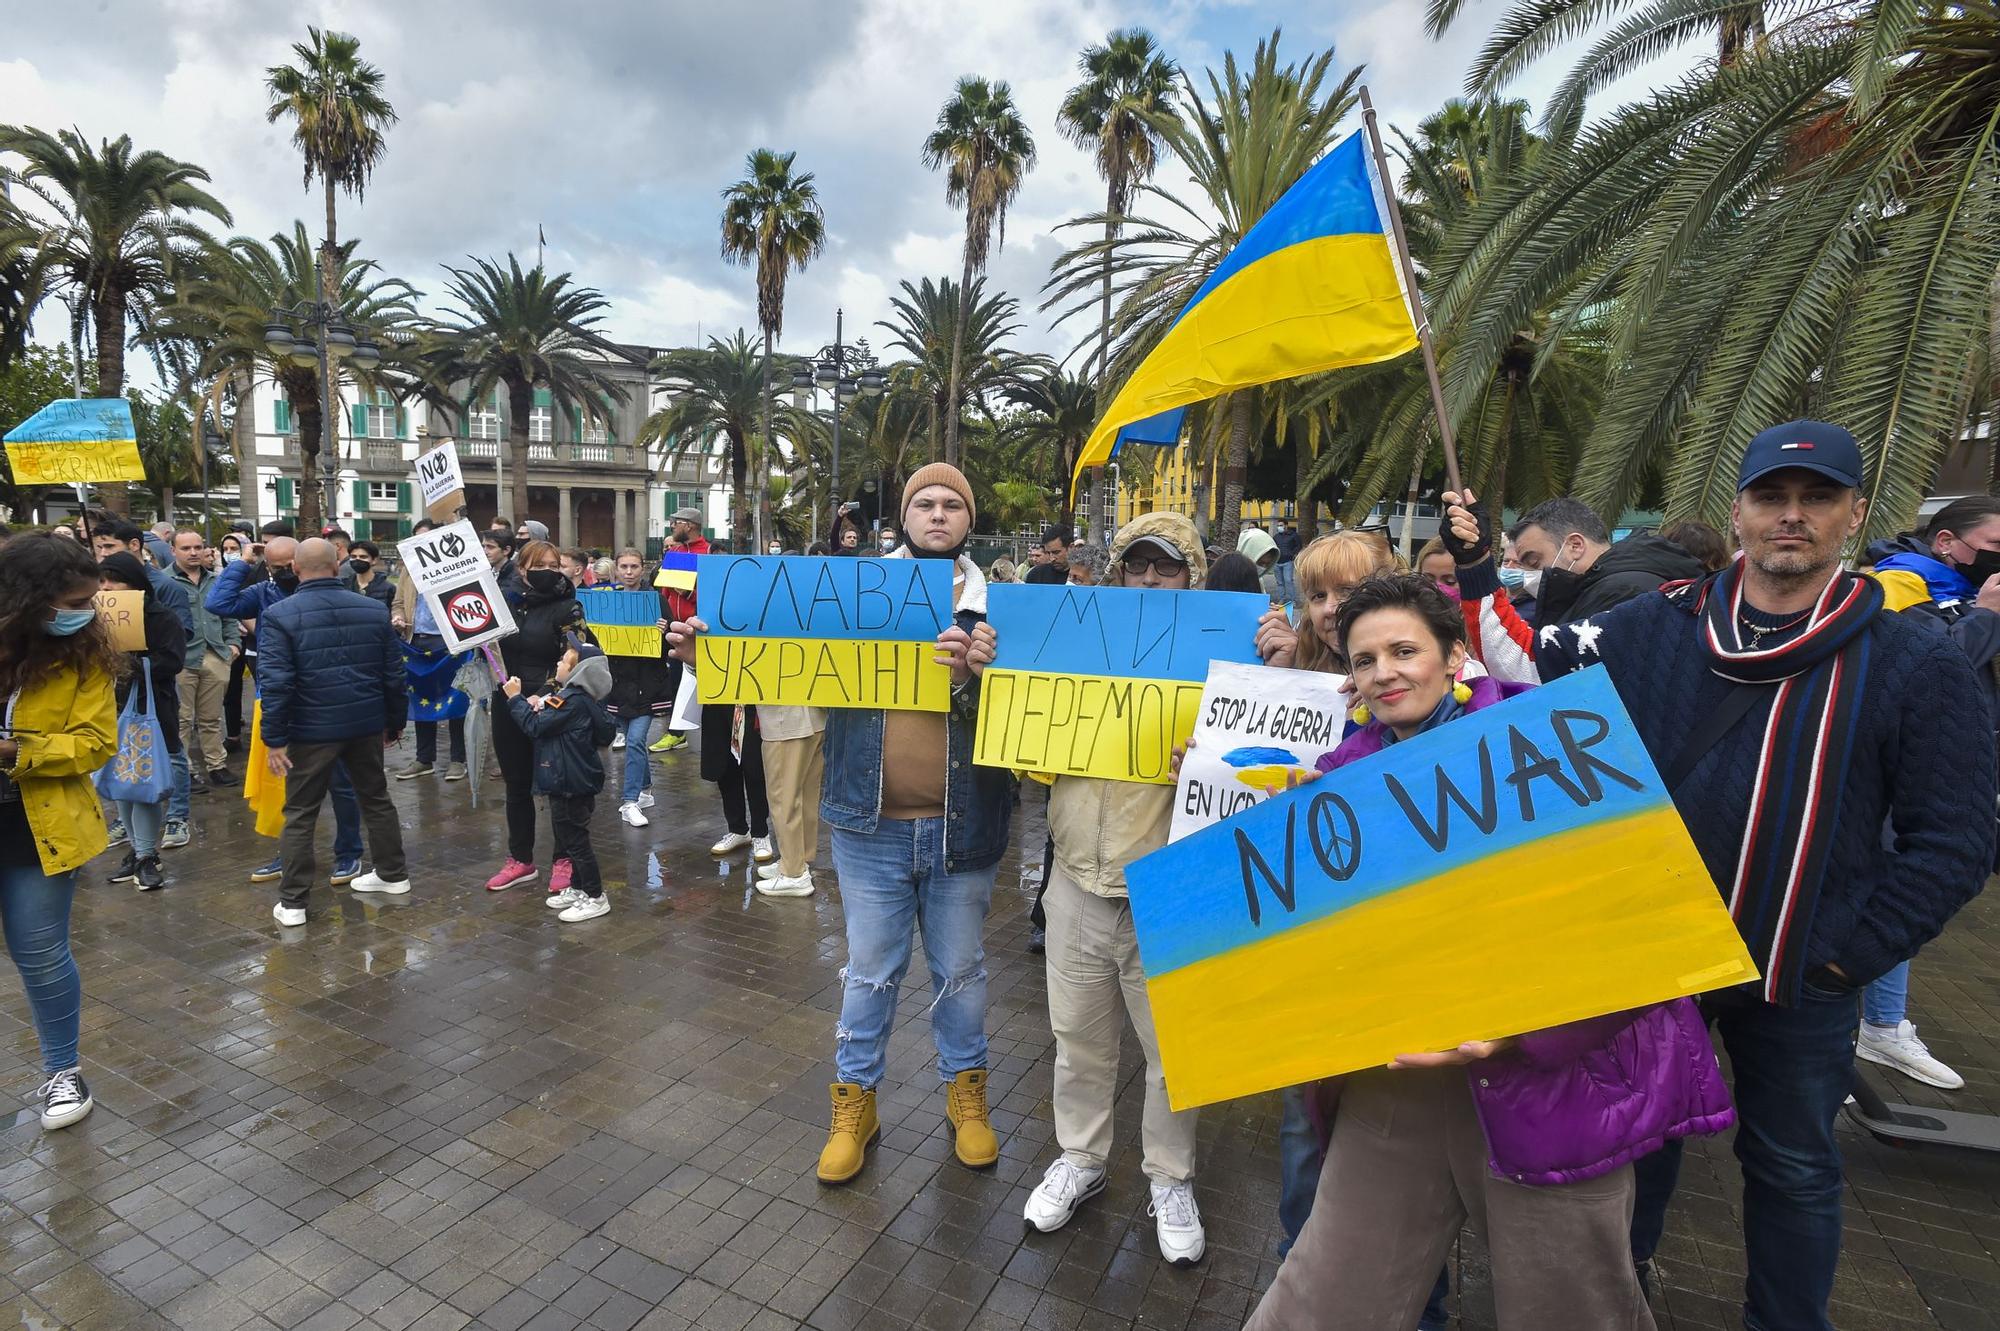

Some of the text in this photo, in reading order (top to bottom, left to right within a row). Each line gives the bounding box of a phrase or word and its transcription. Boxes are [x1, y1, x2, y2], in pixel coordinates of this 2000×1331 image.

[36, 401, 87, 421] UTIN
[38, 456, 133, 481] UKRAINE
[420, 451, 448, 484] NO
[434, 474, 455, 489] GUERRA
[414, 532, 466, 568] NO
[422, 556, 479, 581] A LA GUERRA
[94, 594, 117, 608] NO
[452, 599, 488, 624] WAR
[576, 591, 658, 624] TOP PUTIN
[718, 557, 943, 634] СЛАВА
[103, 610, 131, 626] AR
[590, 625, 662, 655] OP WAR
[704, 638, 924, 706] УКРАЇНІ
[981, 673, 1204, 782] ПЕРЕМОГ
[1206, 697, 1334, 747] STOP LA GUERRA
[1185, 780, 1213, 818] EN
[1233, 708, 1647, 928] NO WAR
